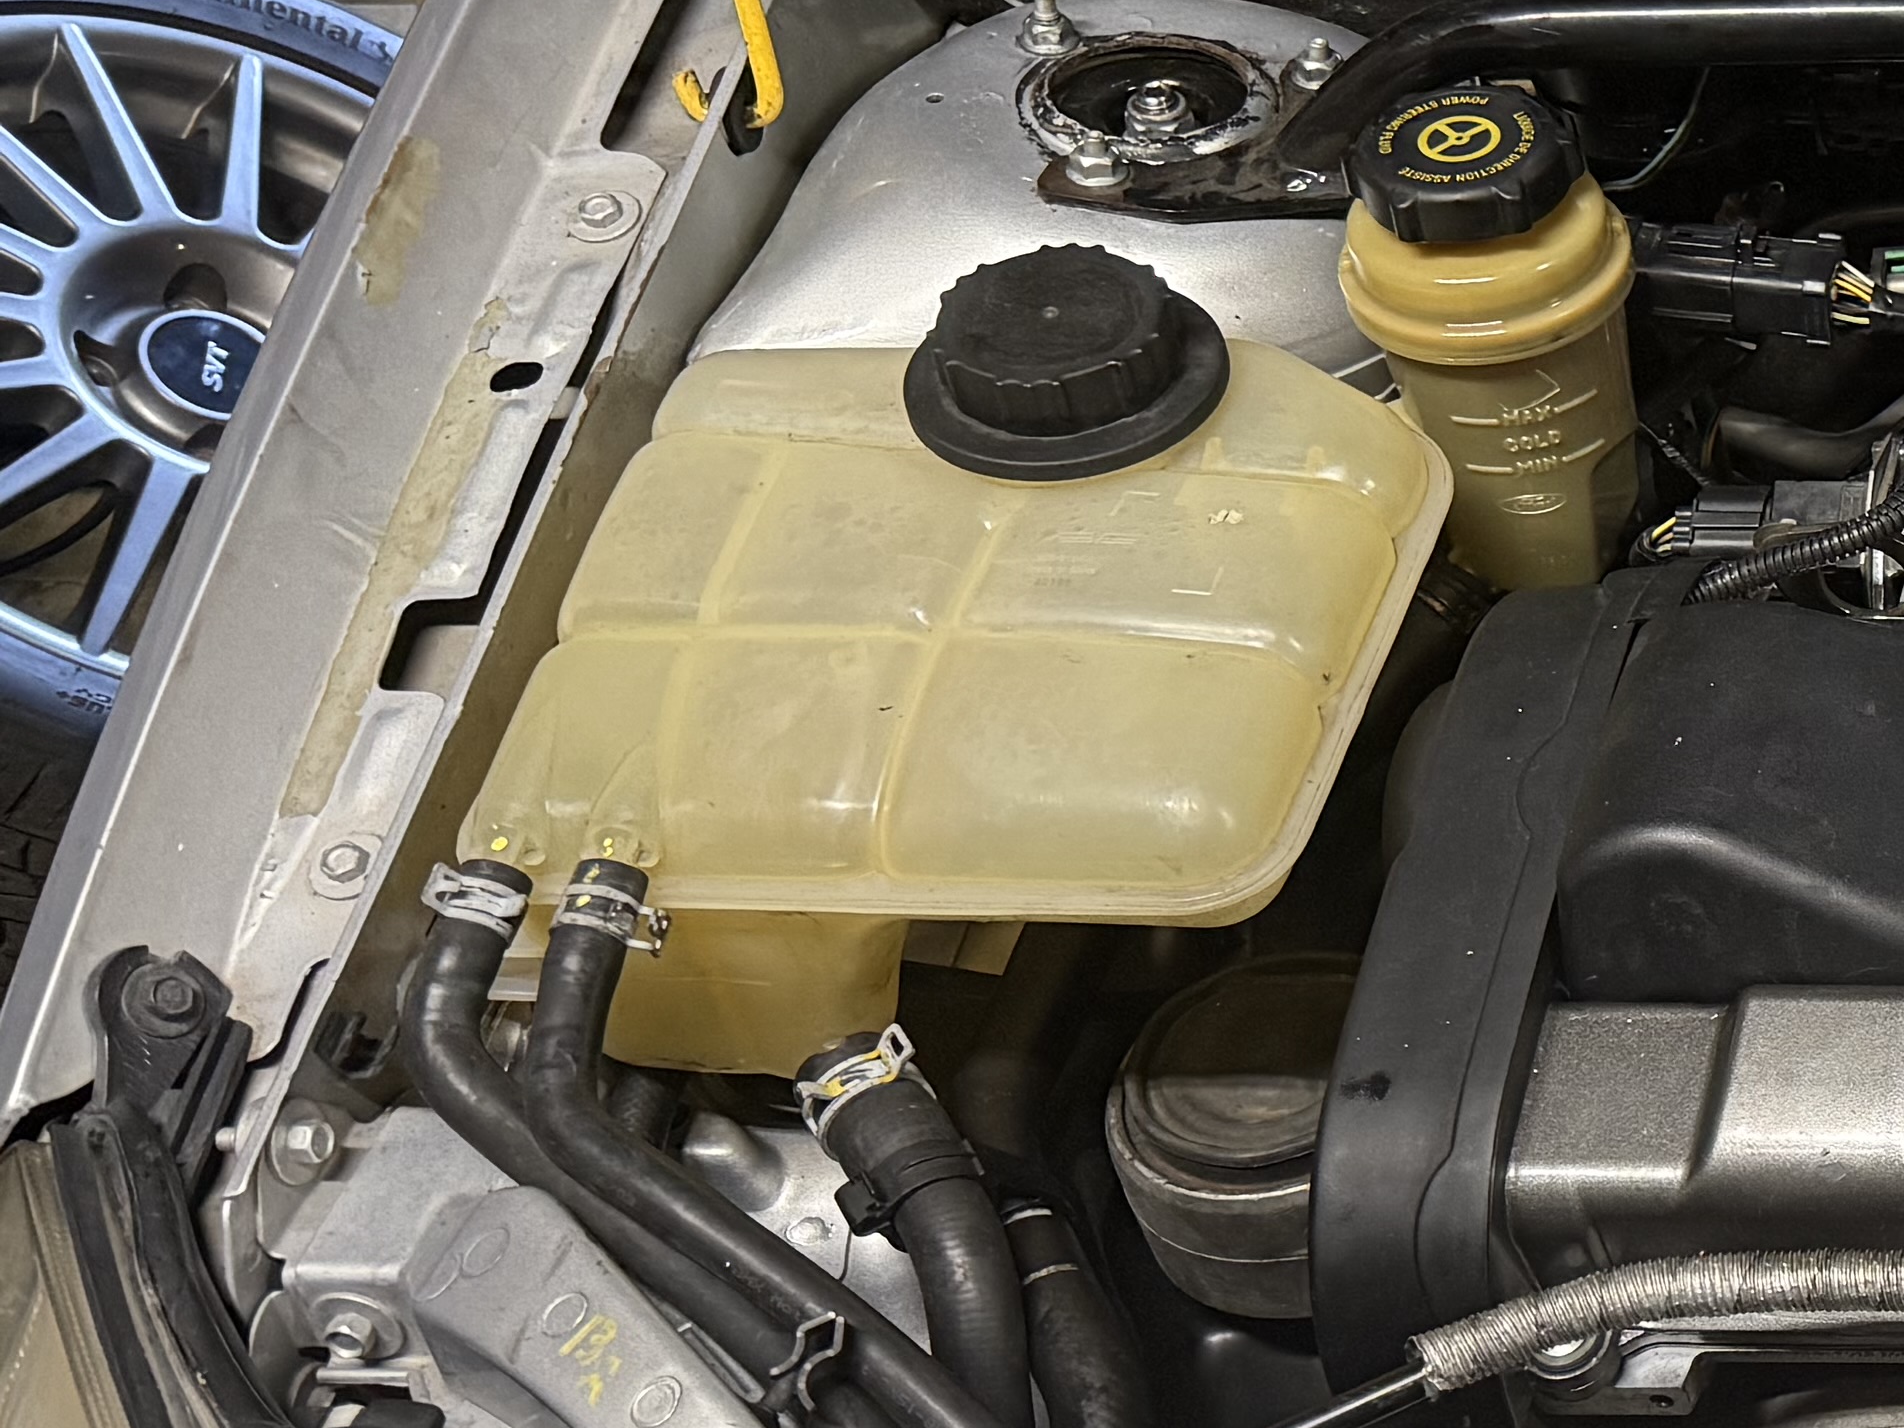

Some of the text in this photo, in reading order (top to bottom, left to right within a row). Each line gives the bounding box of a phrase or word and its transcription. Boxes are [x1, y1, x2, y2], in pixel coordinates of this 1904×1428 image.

[1441, 96, 1490, 106] POWER
[1386, 101, 1439, 131] STEERING
[201, 340, 229, 392] SVT
[1504, 430, 1561, 452] COLD
[1515, 455, 1558, 473] MIN
